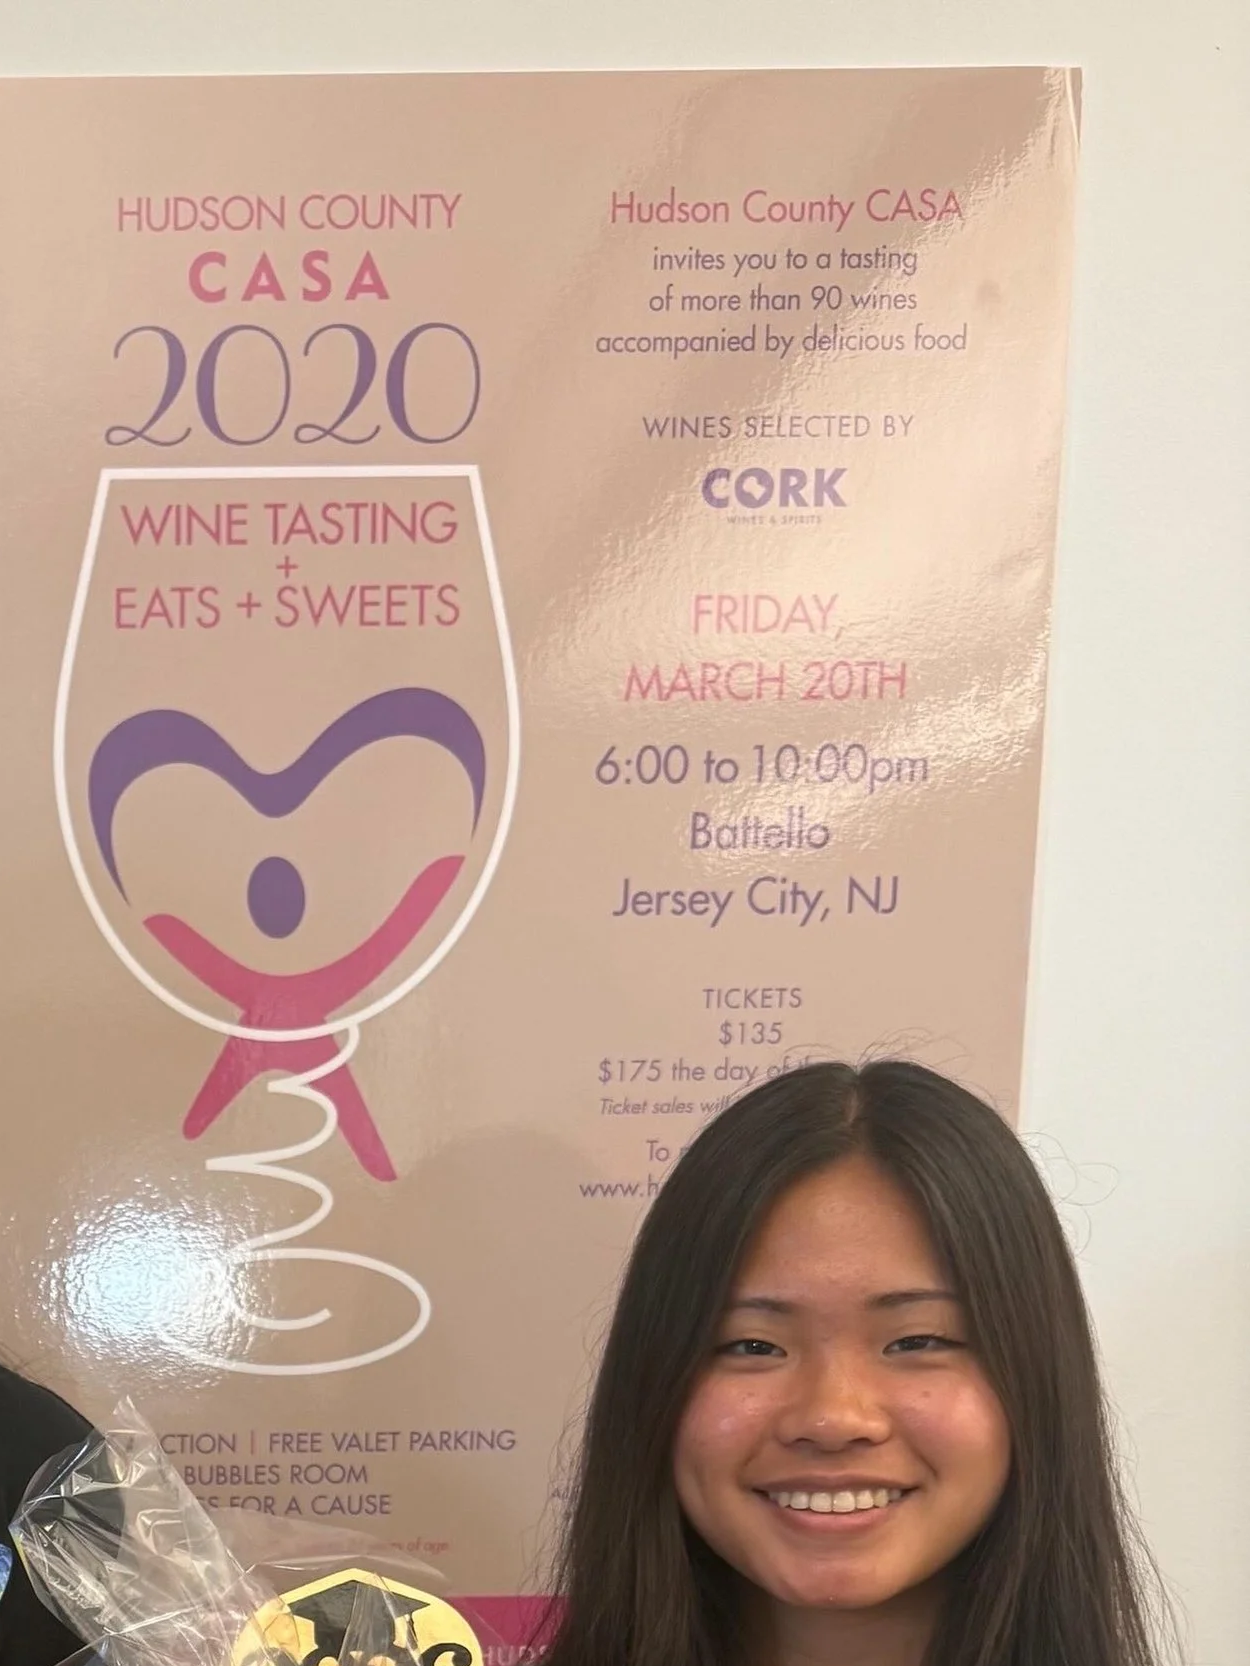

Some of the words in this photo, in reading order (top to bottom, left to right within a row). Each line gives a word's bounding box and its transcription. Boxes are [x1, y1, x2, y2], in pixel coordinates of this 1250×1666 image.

[117, 195, 287, 232] HUDSON
[298, 193, 463, 230] COUNTY
[610, 186, 730, 225] Hudson
[742, 190, 855, 233] County
[864, 187, 965, 223] CASA
[187, 248, 391, 303] CASA
[652, 245, 726, 271] invites
[733, 252, 778, 279] you
[785, 247, 809, 271] to
[815, 254, 832, 271] a
[839, 245, 919, 277] tasting
[648, 283, 674, 312] of
[680, 291, 742, 312] more
[749, 283, 801, 312] than
[810, 285, 844, 312] 90
[850, 285, 919, 311] wines
[595, 325, 757, 360] accompanied
[764, 324, 795, 360] by
[801, 322, 906, 353] delicious
[913, 322, 968, 352] food
[103, 321, 482, 448] 2020
[641, 415, 733, 439] WINES
[743, 414, 871, 439] SELECTED
[882, 414, 915, 438] BY
[701, 466, 849, 510] CORK
[120, 503, 249, 546] WINE
[263, 500, 459, 546] TASTING
[113, 585, 222, 631] EATS
[236, 592, 262, 620] +
[274, 583, 461, 628] SWEETS
[692, 592, 847, 640] FRIDAY,
[623, 660, 786, 702] MARCH
[800, 659, 908, 701] 20TH
[594, 744, 690, 786] 6:00
[703, 749, 740, 785] to
[752, 741, 930, 795] 10:00pm
[689, 805, 831, 852] Battello
[612, 878, 734, 928] Jersey
[746, 874, 831, 926] City,
[847, 874, 900, 916] NJ
[702, 987, 803, 1010] TICKETS
[718, 1020, 783, 1047] $135
[597, 1057, 662, 1085] $175
[671, 1057, 706, 1083] the
[713, 1056, 759, 1087] day
[766, 1054, 791, 1079] of
[600, 1097, 648, 1116] Ticket
[651, 1097, 694, 1115] sales
[646, 1139, 670, 1163] To
[157, 1431, 237, 1455] CTION
[268, 1431, 323, 1454] FREE
[330, 1430, 402, 1453] VALET
[408, 1428, 518, 1452] PARKING
[184, 1463, 281, 1486] BUBBLES
[289, 1463, 369, 1486] ROOM
[284, 1494, 304, 1516] A
[310, 1493, 392, 1516] CAUSE
